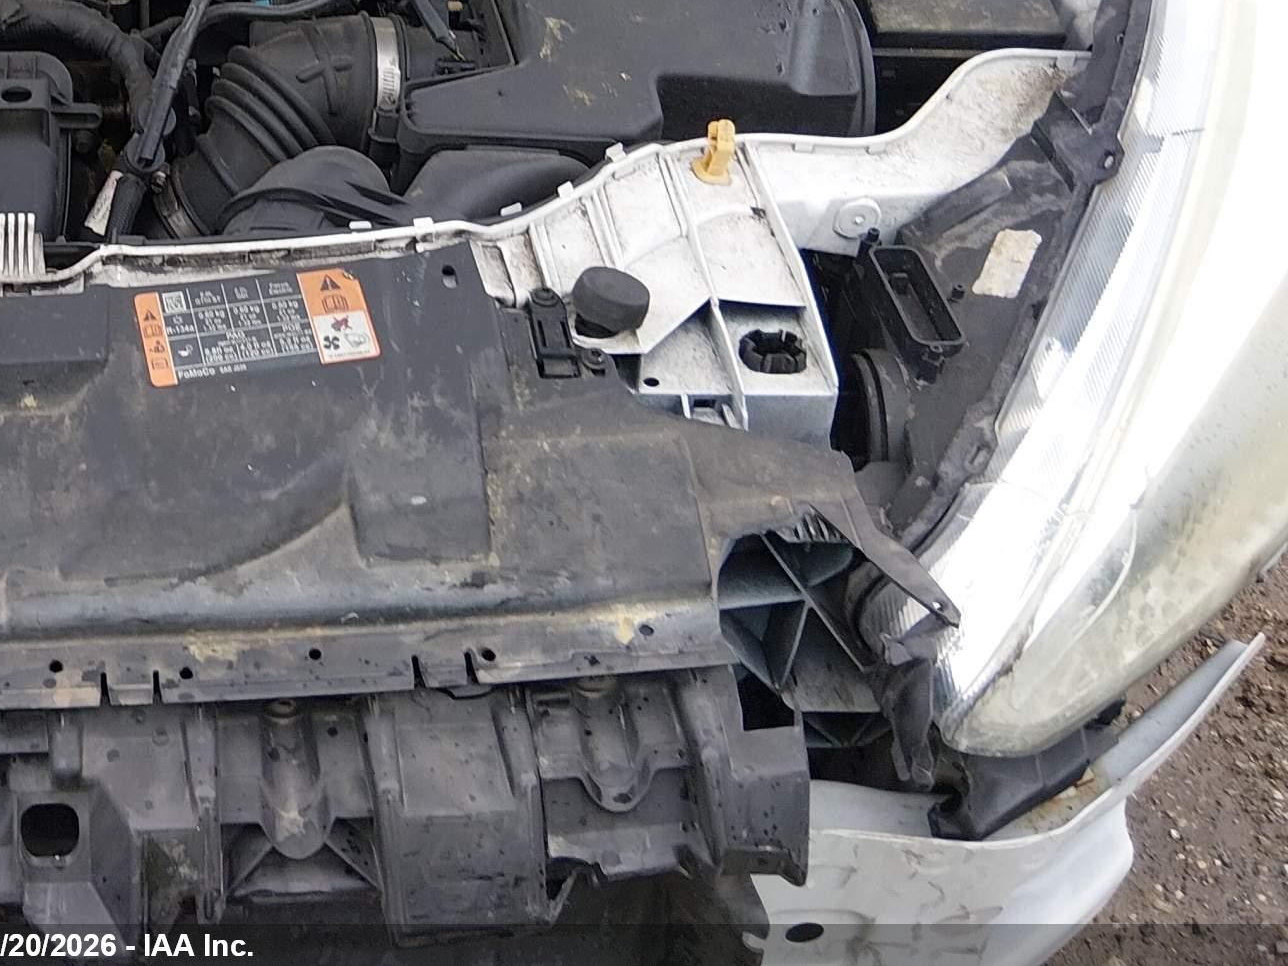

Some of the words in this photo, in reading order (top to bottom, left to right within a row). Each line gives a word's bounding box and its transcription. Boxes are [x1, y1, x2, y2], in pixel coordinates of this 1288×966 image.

[288, 300, 299, 309] kg
[215, 310, 225, 319] kg
[250, 306, 260, 314] kg
[166, 325, 195, 335] R-134a
[178, 367, 215, 379] FoMoCo
